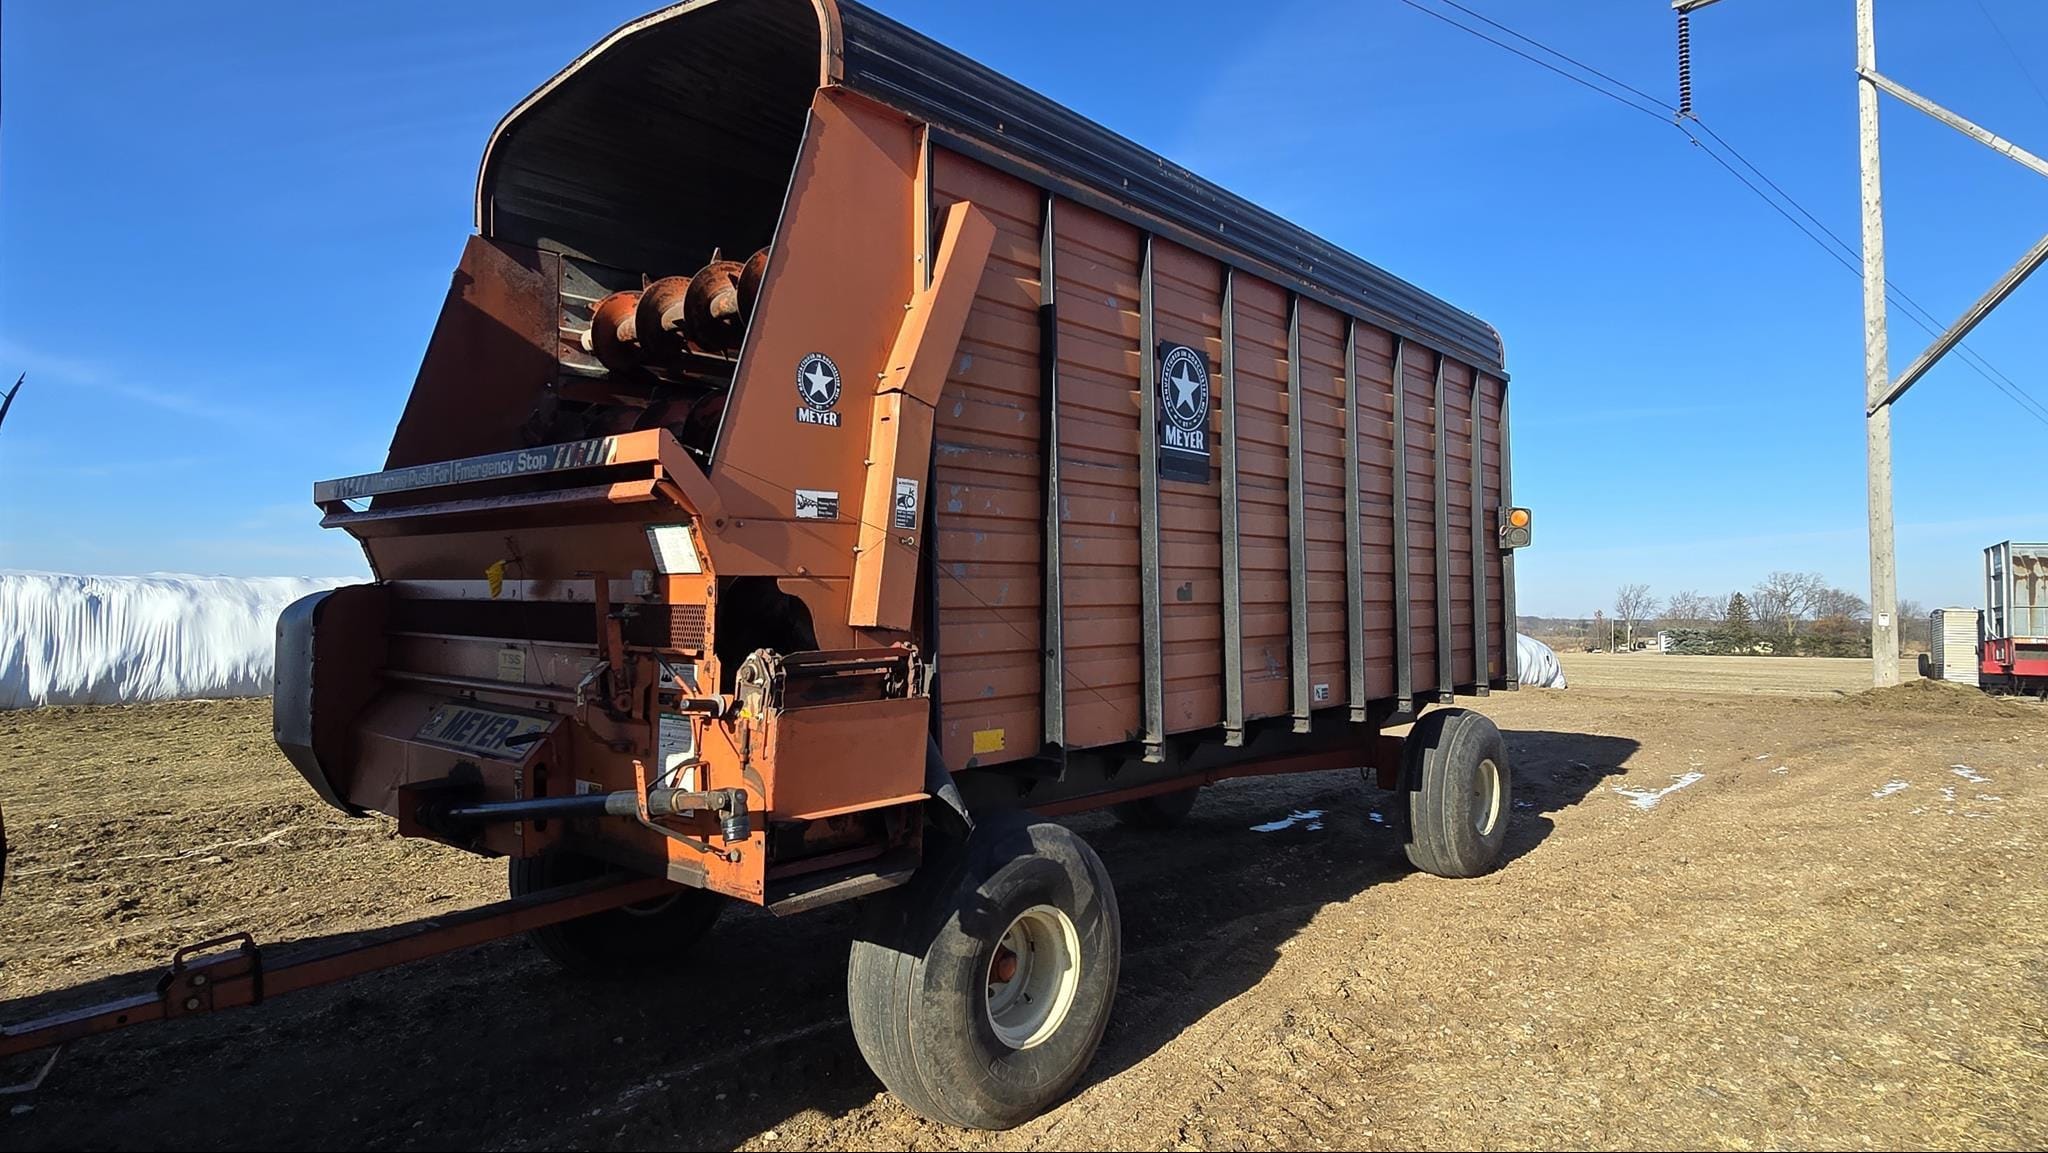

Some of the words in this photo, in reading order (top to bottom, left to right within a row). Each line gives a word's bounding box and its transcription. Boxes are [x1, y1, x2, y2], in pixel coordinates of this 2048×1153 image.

[798, 407, 838, 427] MEYER
[1165, 424, 1205, 450] MEYER
[408, 467, 432, 485] Push
[433, 465, 450, 482] For
[454, 457, 514, 481] Emergency
[517, 453, 547, 473] Stop
[501, 652, 521, 665] TSS
[439, 710, 519, 749] MEYER
